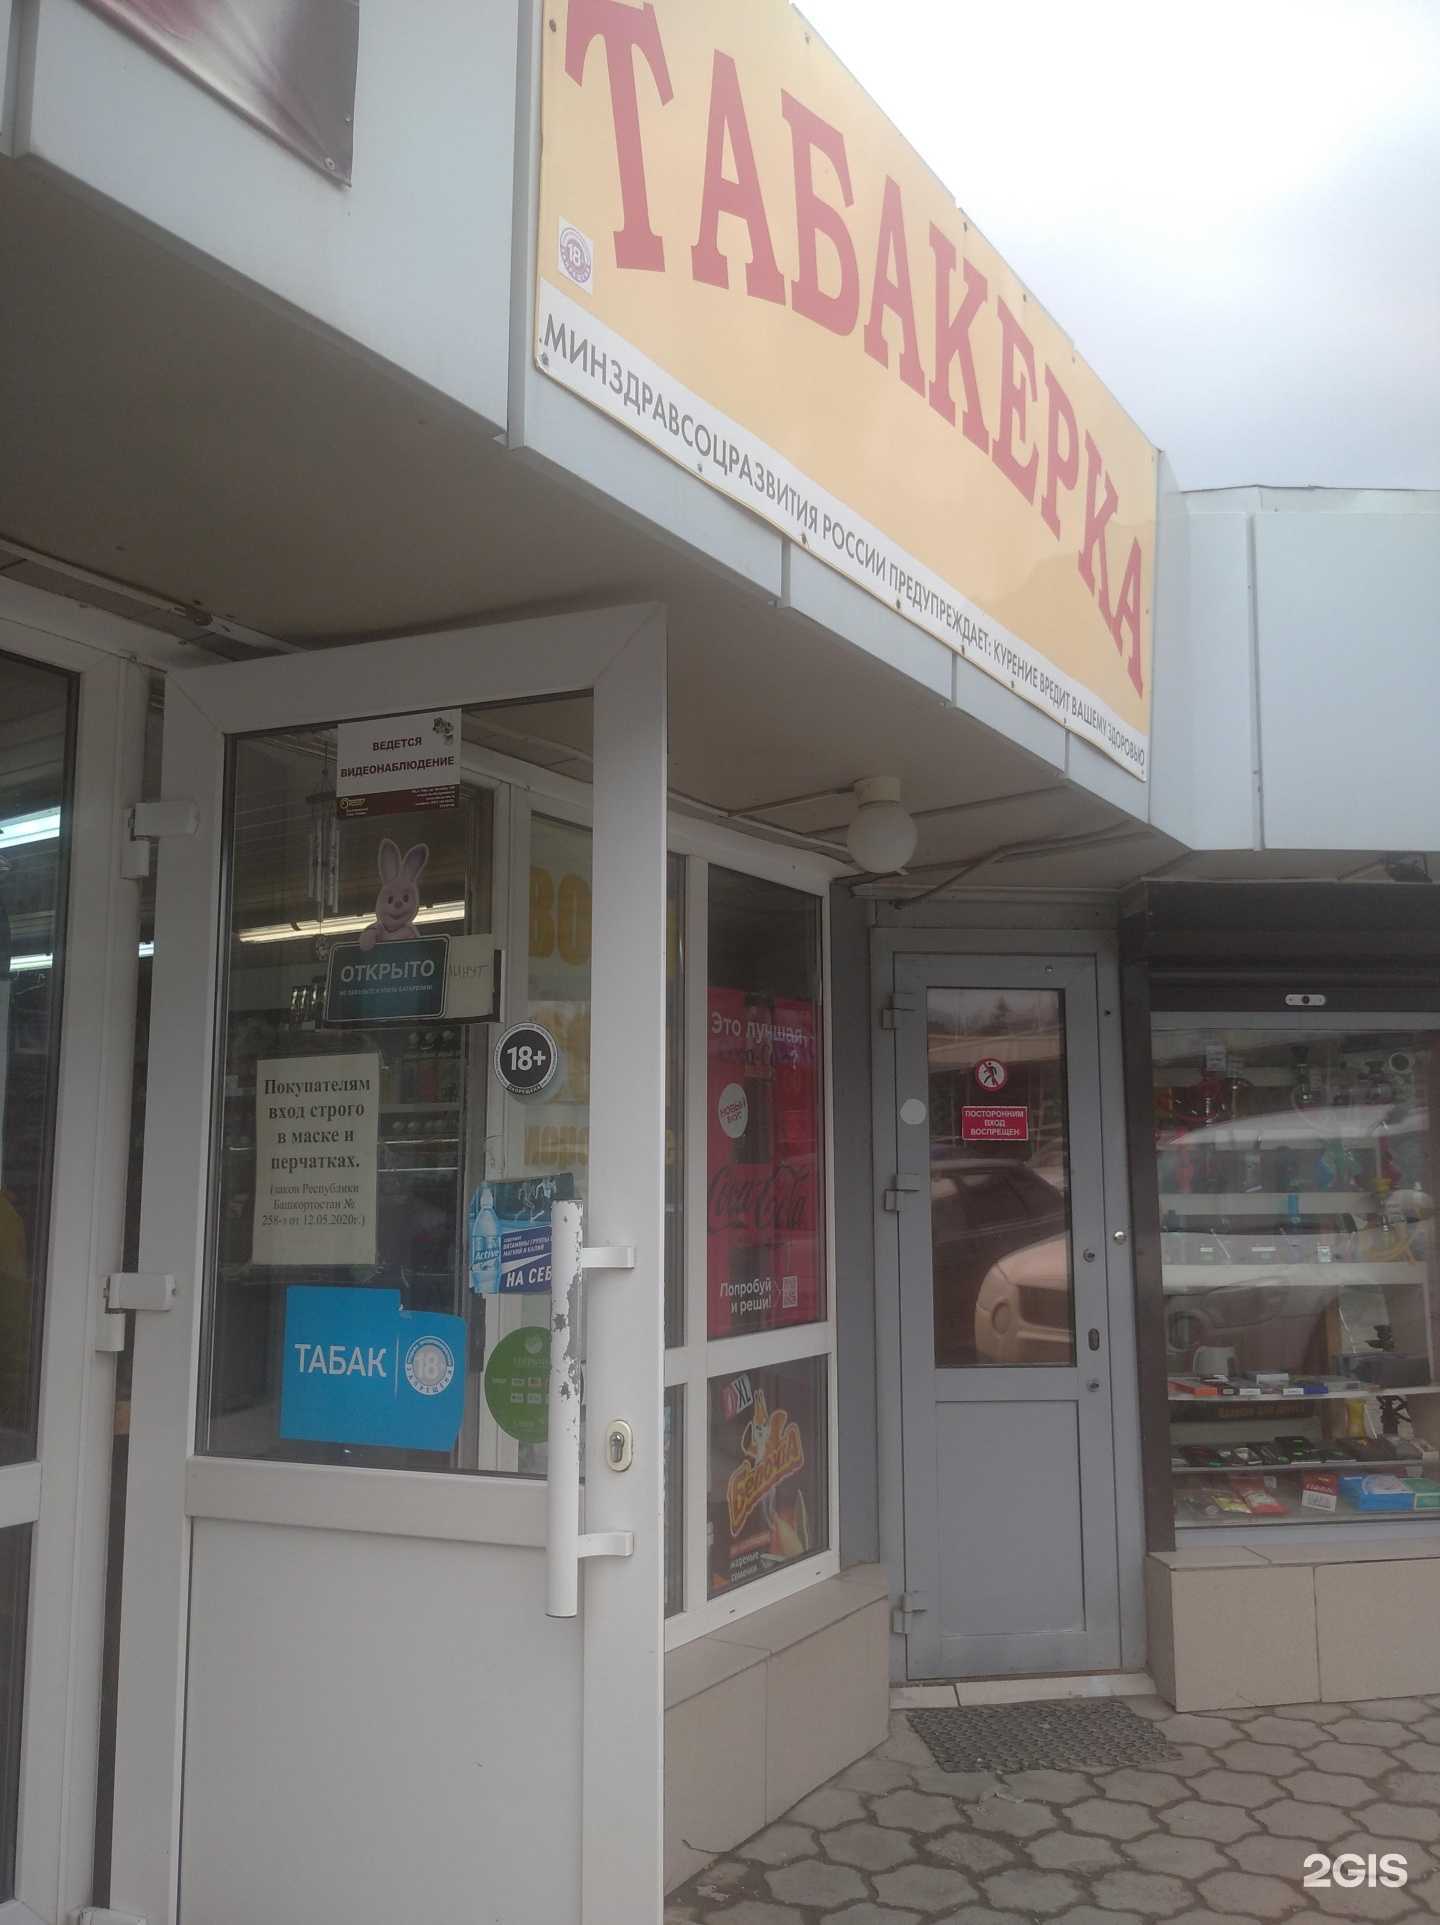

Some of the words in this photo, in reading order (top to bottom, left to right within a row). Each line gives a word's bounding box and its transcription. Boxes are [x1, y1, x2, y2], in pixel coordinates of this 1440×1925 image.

[565, 0, 1144, 700] ТАБАКЕРКА
[544, 313, 817, 535] МИНЗДРАВСОЦРАЗВИТИЯ
[823, 512, 887, 582] РОССИИ
[889, 563, 993, 657] ПРЕДУПРЕЖДАЕТ:
[993, 639, 1038, 689] КУРЕНИЕ
[1039, 671, 1070, 713] ВРЕДИТ
[1071, 697, 1108, 736] ВАШЕМУ
[1107, 722, 1145, 767] ЗДОРОВЬЮ
[372, 736, 422, 751] ВЕДЕТСЯ
[340, 756, 455, 778] ВИДЕОНАБЛЮДЕНИЕ
[340, 959, 435, 983] ОТКРЫТО
[711, 1011, 742, 1037] Это
[506, 1045, 547, 1072] 18+
[264, 1079, 371, 1098] Покупателям
[269, 1106, 304, 1120] вход
[310, 1103, 365, 1122] строго
[965, 1110, 1024, 1118] ПОСТОРОННИМ
[970, 1128, 1020, 1136] ВОСПРЕЩЕН
[984, 1119, 1006, 1127] ВХОД
[278, 1132, 287, 1144] в
[292, 1130, 340, 1144] маске
[344, 1130, 354, 1142] и
[271, 1156, 360, 1174] перчатках.
[302, 1183, 359, 1197] Республики
[506, 1270, 524, 1288] НА
[528, 1265, 551, 1285] СЕБ
[720, 1278, 772, 1298] Попробуй
[731, 1300, 738, 1313] и
[740, 1294, 772, 1316] реши!
[294, 1344, 387, 1378] ТАБАК
